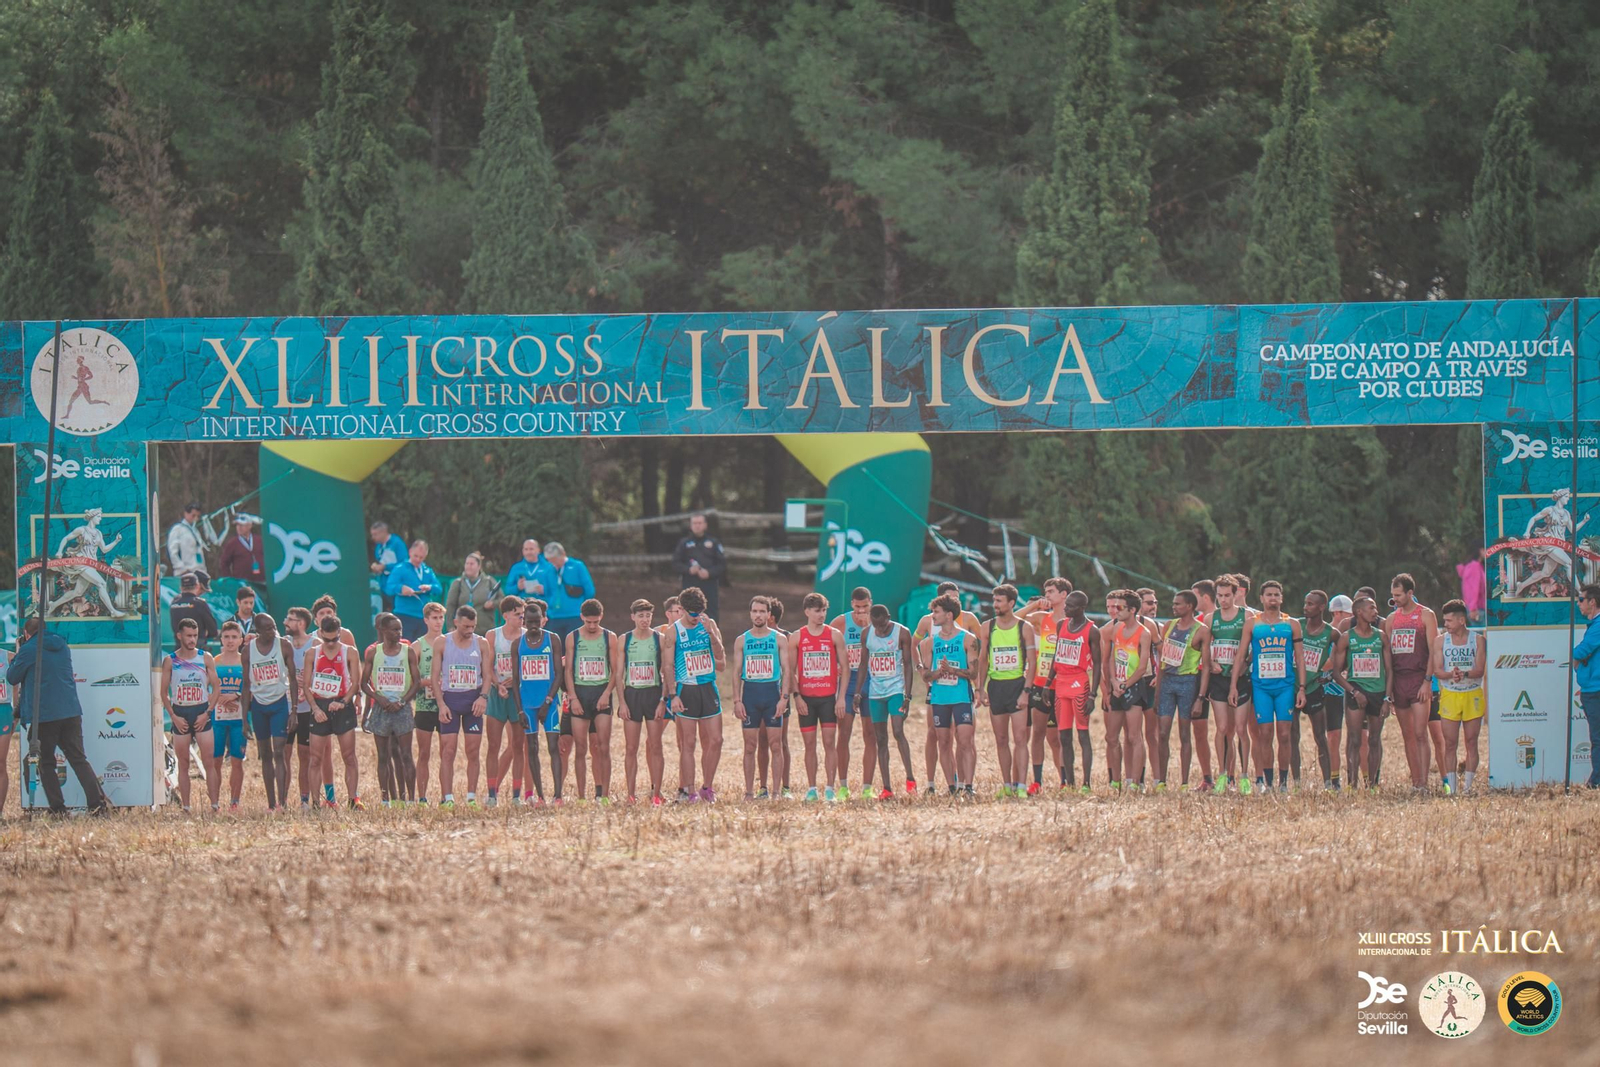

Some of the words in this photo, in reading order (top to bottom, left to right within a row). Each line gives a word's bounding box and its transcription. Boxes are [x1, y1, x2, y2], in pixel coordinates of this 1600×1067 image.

[1260, 342, 1410, 361] CAMPEONATO
[1414, 341, 1441, 359] DE
[1446, 336, 1575, 358] ANDALUCÍA
[430, 335, 603, 377] CROSS
[685, 311, 1111, 410] ITÁLICA
[202, 336, 425, 409] XLIII
[1310, 363, 1337, 380] DE
[1341, 361, 1421, 379] CAMPO
[1425, 360, 1443, 378] A
[1446, 356, 1527, 378] TRAVÉS
[431, 381, 668, 406] INTERNACIONAL
[1359, 381, 1402, 399] POR
[1405, 379, 1484, 398] CLUBES
[202, 413, 413, 437] INTERNATIONAL
[419, 413, 497, 434] CROSS
[503, 411, 626, 433] COUNTRY
[1551, 436, 1598, 446] Diputción
[83, 456, 130, 466] Diputación
[84, 465, 130, 478] Sevilla
[680, 639, 703, 649] TOLOSA
[747, 639, 774, 650] nerja
[1259, 636, 1287, 648] UCAM
[1392, 635, 1414, 649] ARCE
[995, 655, 1017, 664] 5126
[1444, 648, 1475, 657] CORIA
[522, 661, 548, 675] KIBET
[687, 655, 712, 672] CIVICO
[870, 657, 896, 672] KOECH
[1040, 661, 1050, 670] 51
[1261, 662, 1283, 671] 5118
[314, 681, 338, 693] 5102
